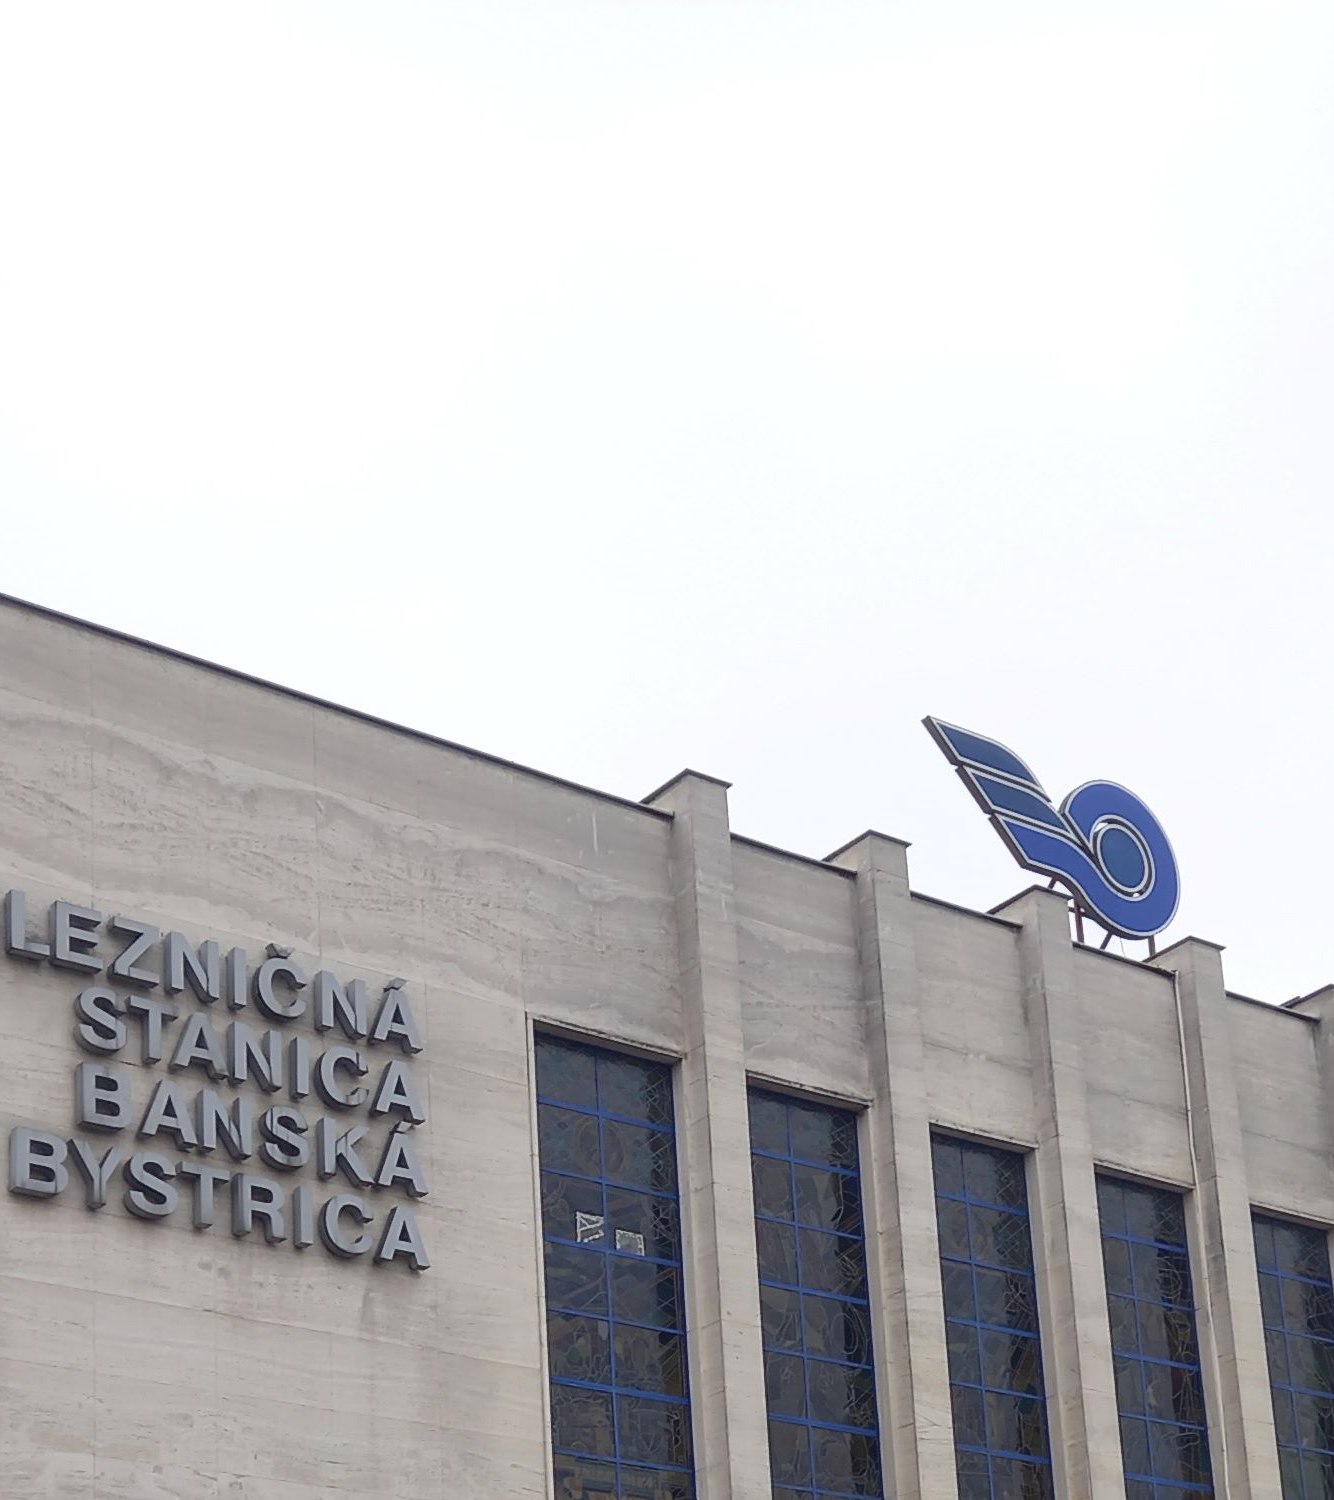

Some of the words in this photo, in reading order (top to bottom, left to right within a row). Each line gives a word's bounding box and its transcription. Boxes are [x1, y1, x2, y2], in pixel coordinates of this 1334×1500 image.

[75, 986, 426, 1125] STANICA
[8, 1126, 431, 1271] BYSTRICA
[75, 1061, 428, 1198] BANSKÁ
